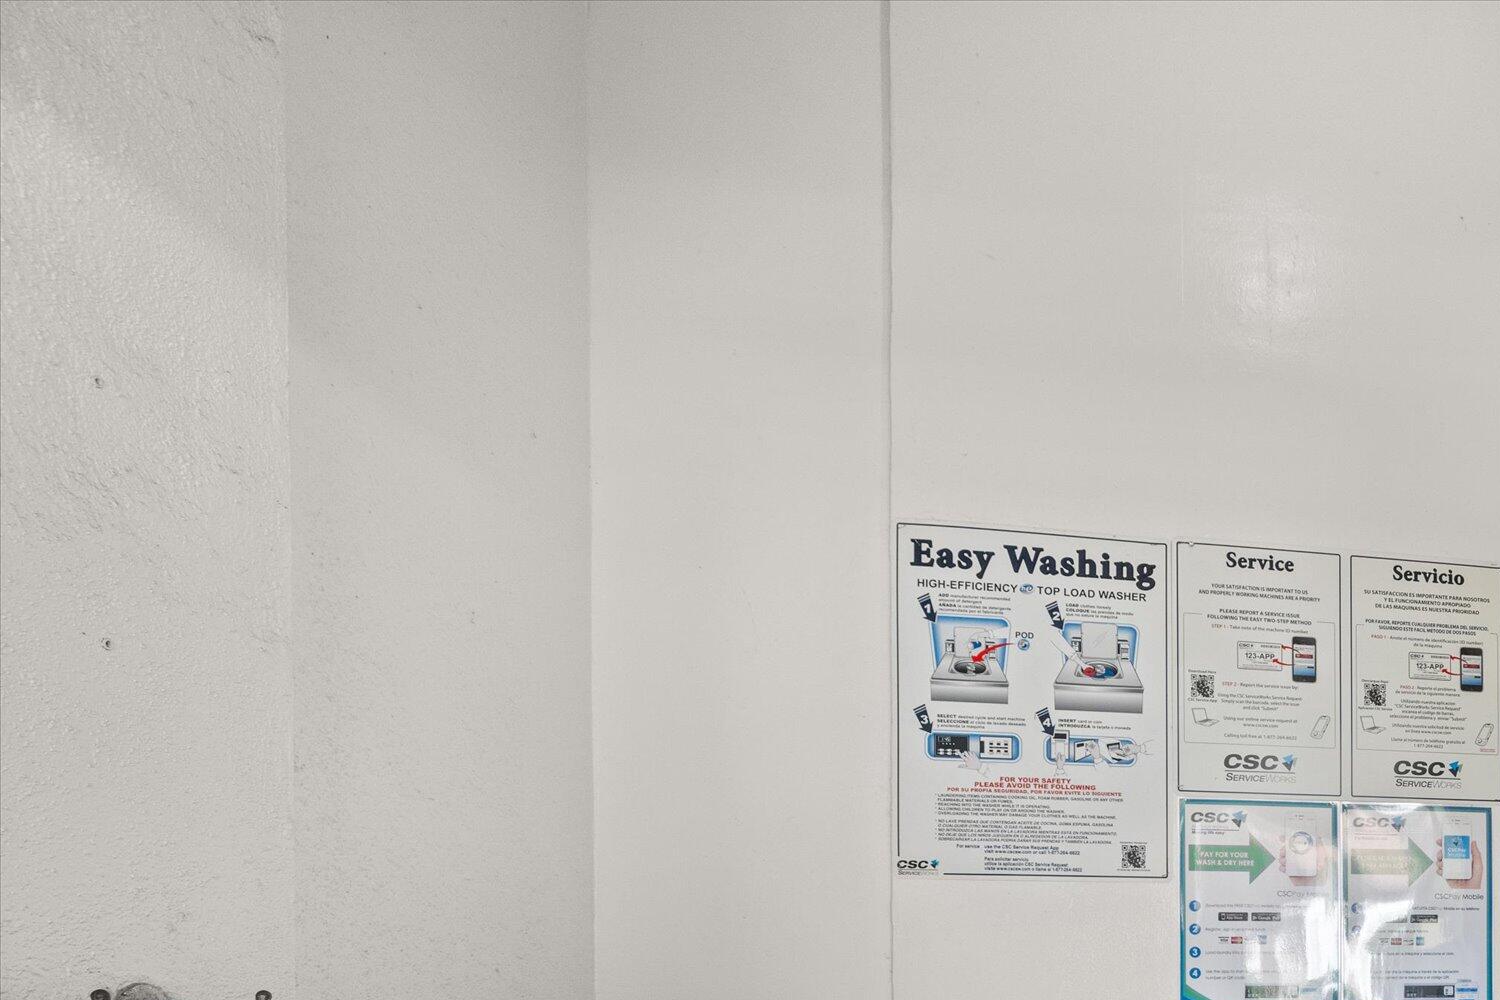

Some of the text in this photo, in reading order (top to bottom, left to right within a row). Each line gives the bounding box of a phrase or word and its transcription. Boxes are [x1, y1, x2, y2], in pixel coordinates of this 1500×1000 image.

[910, 538, 1156, 591] Easy Washing
[1226, 552, 1294, 572] Service
[1392, 565, 1465, 586] Servicio
[917, 579, 1147, 602] HIGH-EFFICIENCY TOP LOAD WASHER
[1395, 598, 1441, 606] FUNCIONAMIENTO
[924, 604, 931, 613] 1
[1052, 612, 1060, 621] 2
[921, 714, 929, 725] 3
[1043, 717, 1051, 727] 4
[1224, 753, 1279, 770] CSC
[1394, 760, 1446, 776] CSC
[1395, 779, 1462, 790] SERVICEWORKS
[1191, 812, 1229, 823] CSC
[1353, 817, 1389, 828] CSC
[897, 860, 929, 869] CSC
[1193, 948, 1198, 956] 3
